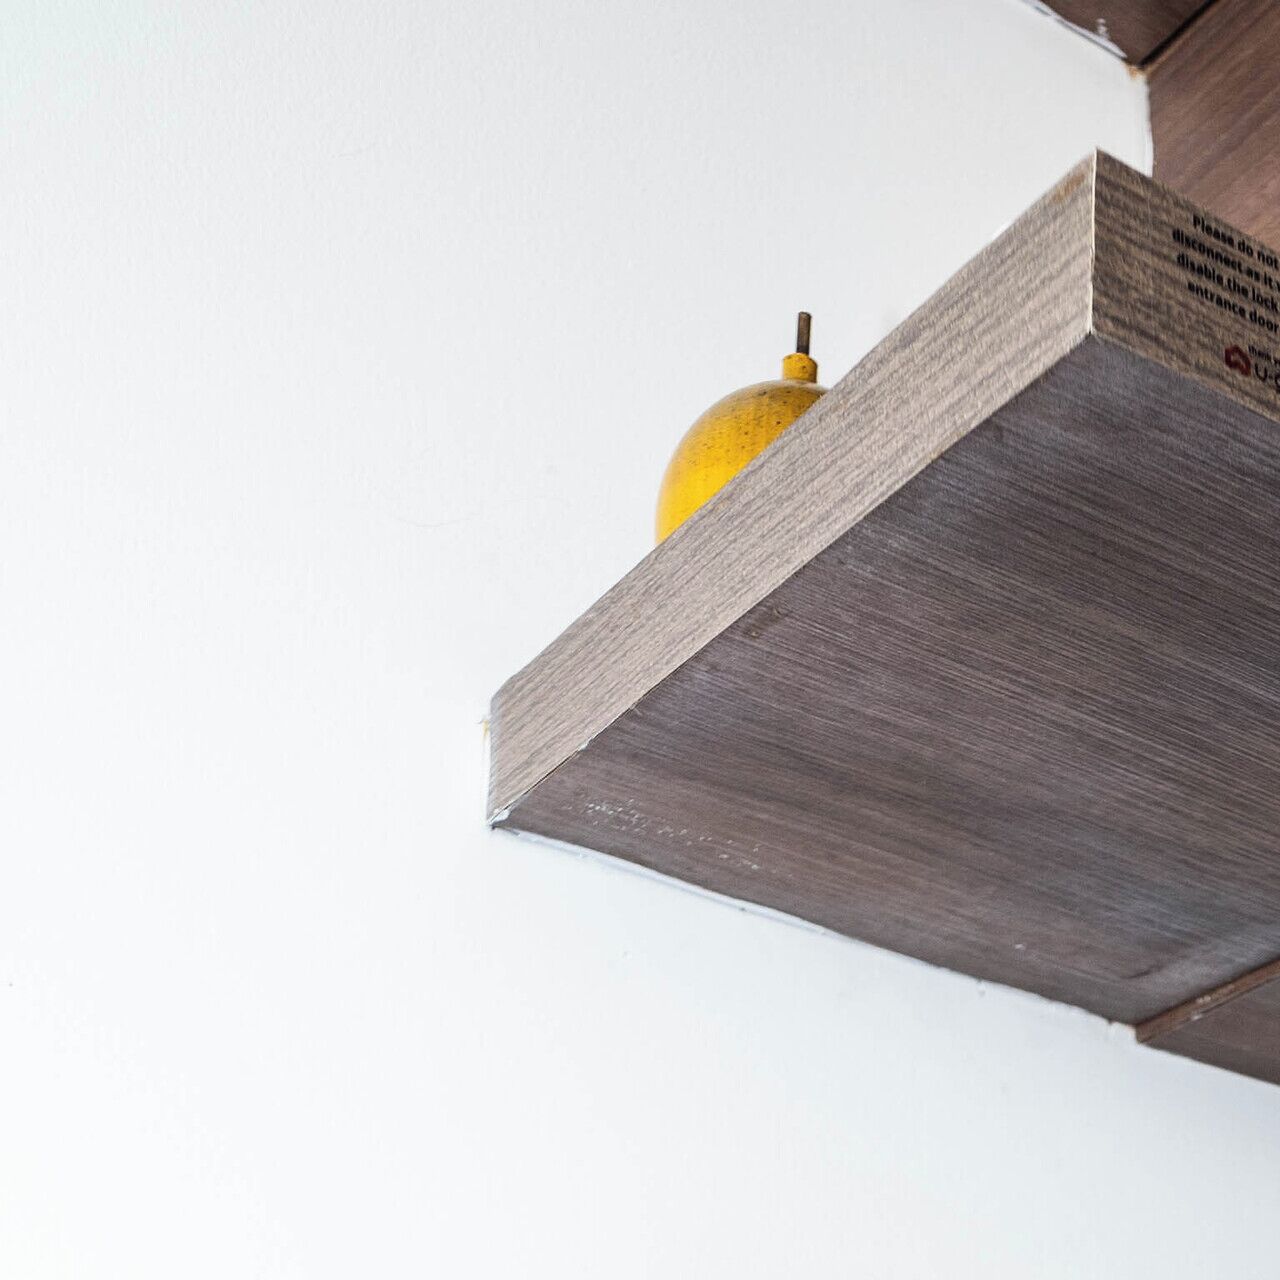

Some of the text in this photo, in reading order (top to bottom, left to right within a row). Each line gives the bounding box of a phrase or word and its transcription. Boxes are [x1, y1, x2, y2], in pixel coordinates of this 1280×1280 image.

[1172, 229, 1242, 274] disconnect
[1246, 266, 1261, 282] as
[1264, 271, 1274, 290] it
[1192, 214, 1279, 271] Please do not
[1177, 252, 1224, 287] disable
[1227, 276, 1249, 299] the
[1252, 285, 1279, 314] lock
[1187, 281, 1246, 319] entrance
